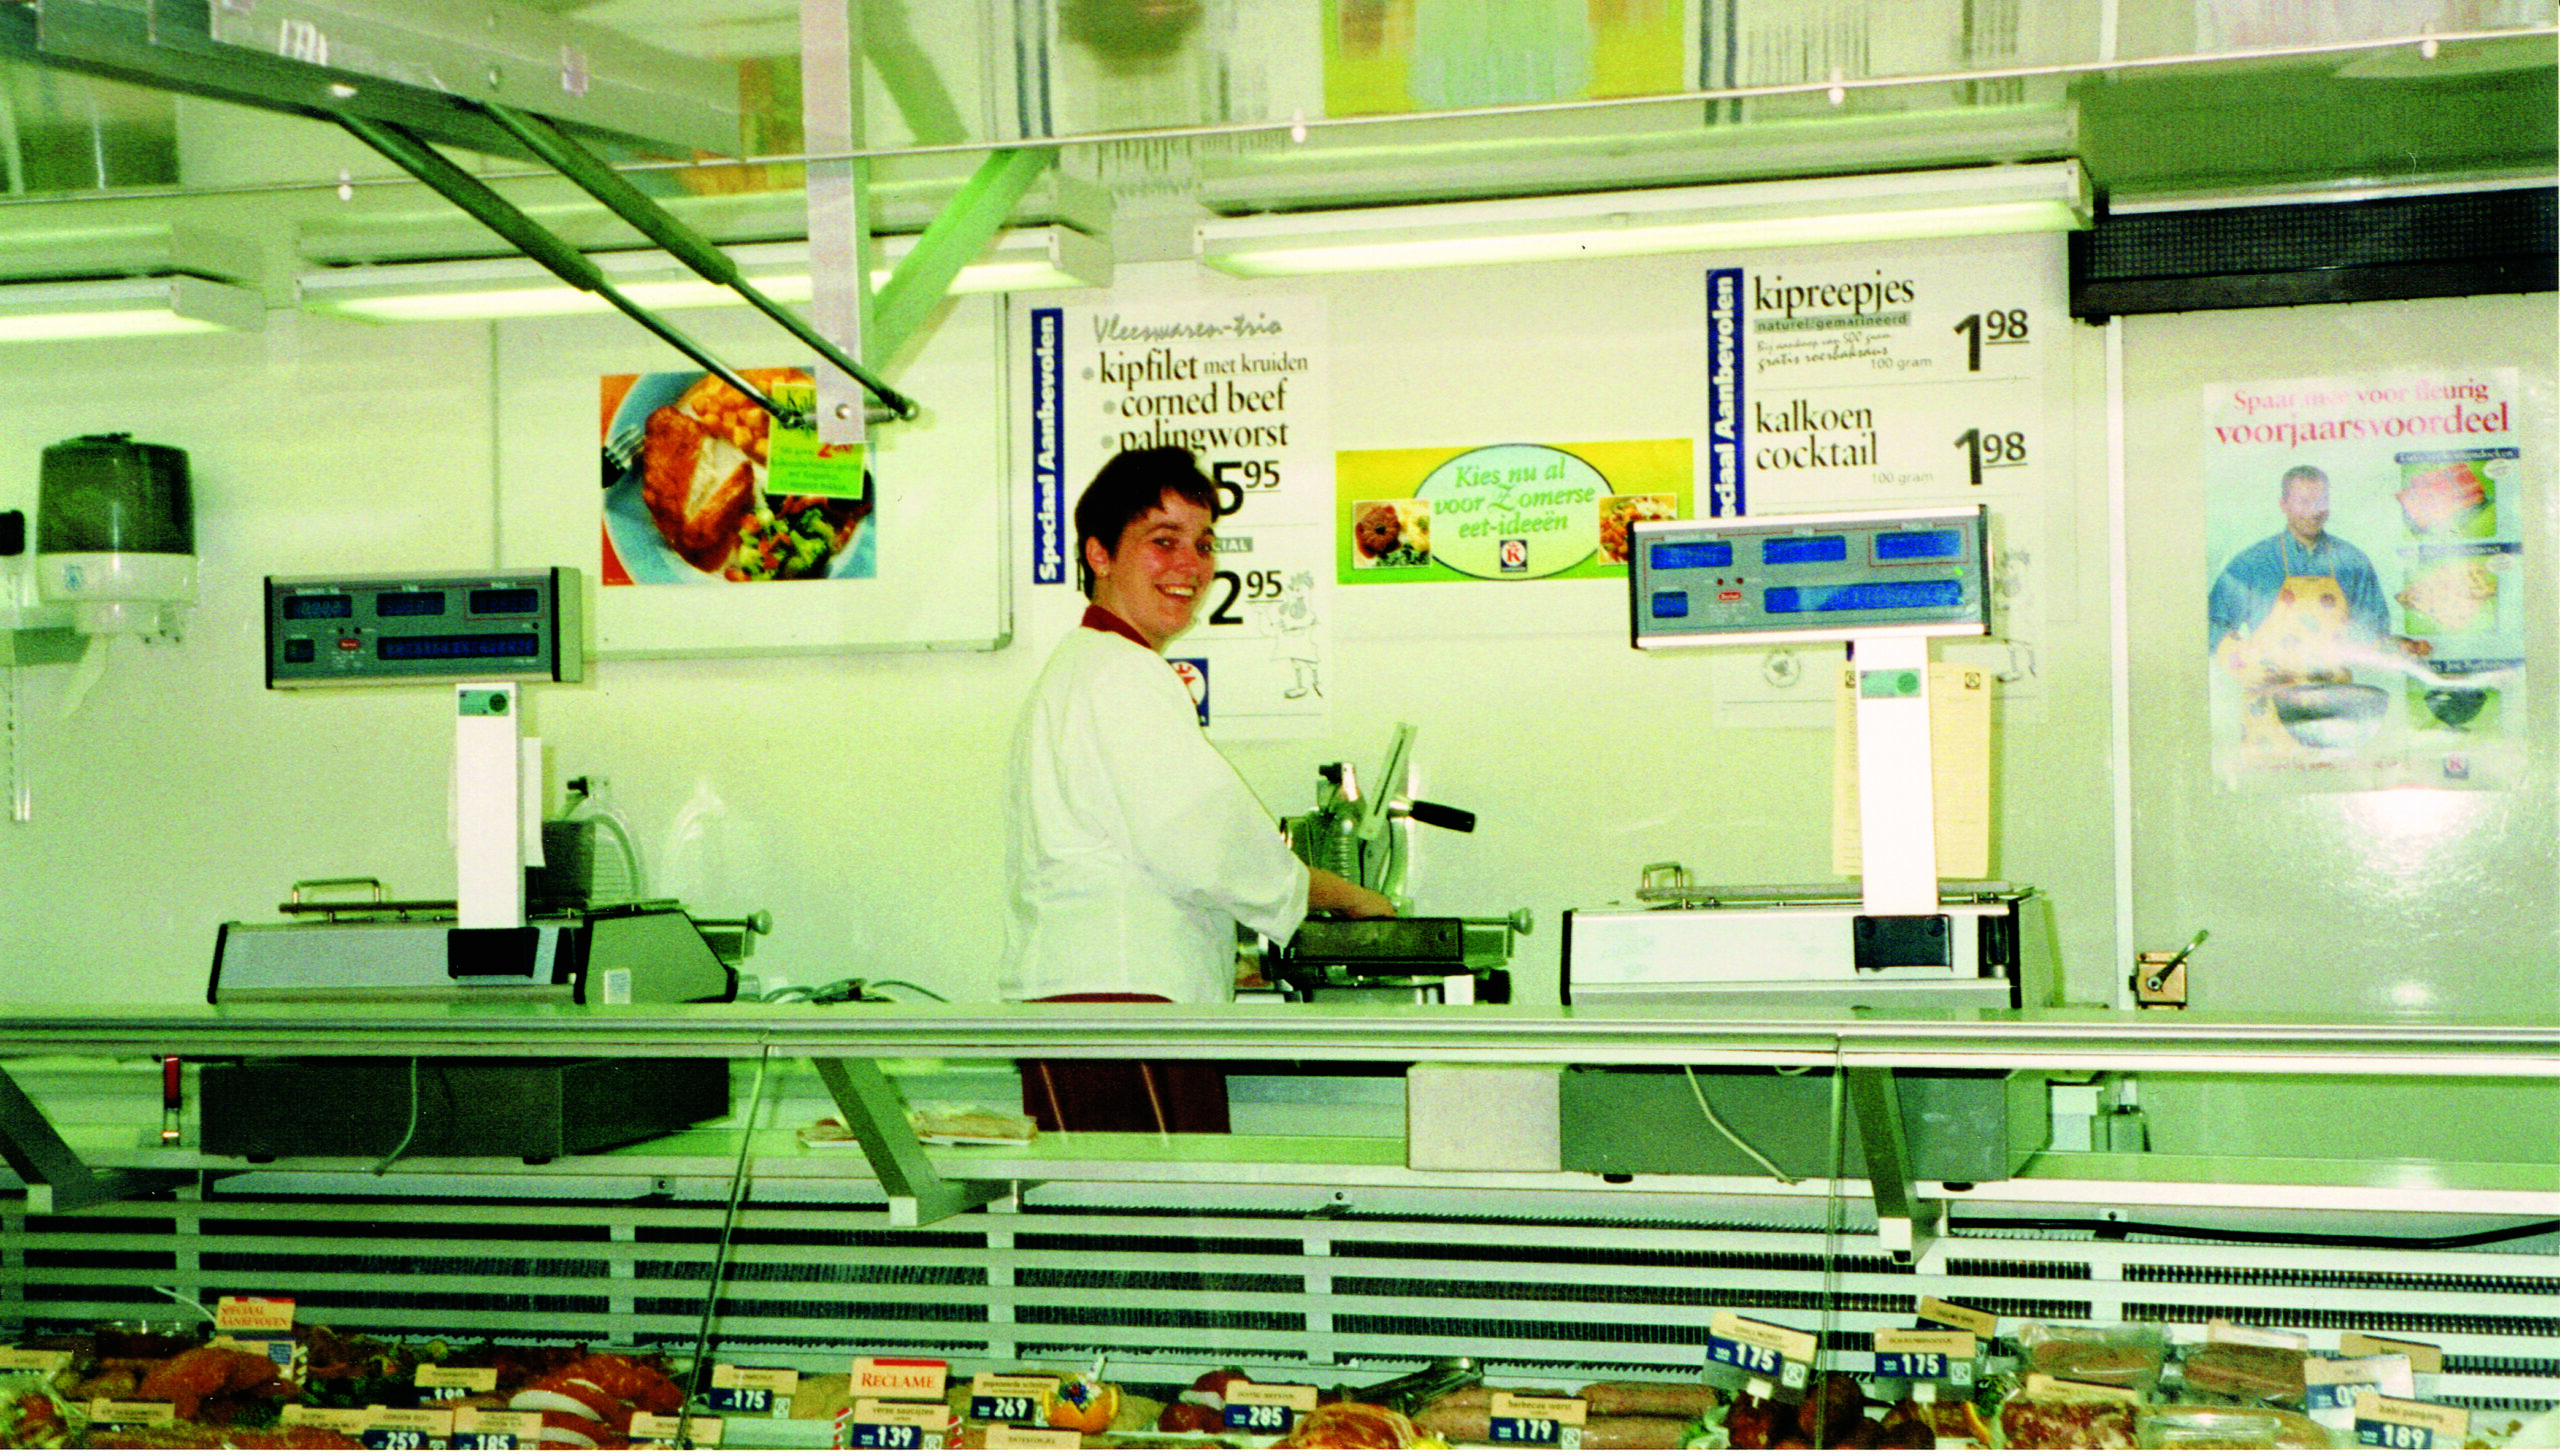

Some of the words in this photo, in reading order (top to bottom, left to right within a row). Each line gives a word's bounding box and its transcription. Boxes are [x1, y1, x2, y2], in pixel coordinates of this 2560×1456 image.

[1754, 269, 1915, 319] kipreepjes
[1100, 348, 1198, 391] kipfilet
[1204, 358, 1237, 376] met
[1241, 352, 1309, 374] kruiden
[1712, 276, 1736, 442] Aanbevolen
[1758, 352, 1800, 374] gratis
[1871, 358, 1893, 370] 100
[1897, 358, 1933, 372] gram
[1036, 315, 1057, 472] Aanbevolen
[1121, 381, 1219, 418] corned
[1228, 378, 1289, 413] beef
[2234, 389, 2294, 415] Spaar
[2356, 387, 2409, 404] voor
[1756, 399, 1874, 434] kalkoen
[2215, 402, 2511, 448] voorjaarsvoordeel
[1120, 419, 1290, 454] palingworst
[1756, 432, 1879, 470] cocktail
[1455, 464, 1499, 488] Kies
[1508, 467, 1537, 485] nu
[1544, 456, 1566, 480] al
[1714, 443, 1737, 517] eciaal
[1434, 495, 1484, 516] voor
[1486, 482, 1596, 513] Zomerse
[1037, 474, 1062, 580] Speciaal
[1458, 513, 1568, 538] eet-ideeën
[1736, 1343, 1776, 1372] 175
[1902, 1354, 1940, 1375] 175
[861, 1372, 936, 1388] RECLAME
[734, 1390, 765, 1408] 175
[994, 1398, 1027, 1418] 269
[1248, 1406, 1283, 1427] 285
[1516, 1419, 1552, 1440] 179
[386, 1432, 420, 1450] 259
[877, 1426, 913, 1448] 139
[2383, 1424, 2426, 1449] 189
